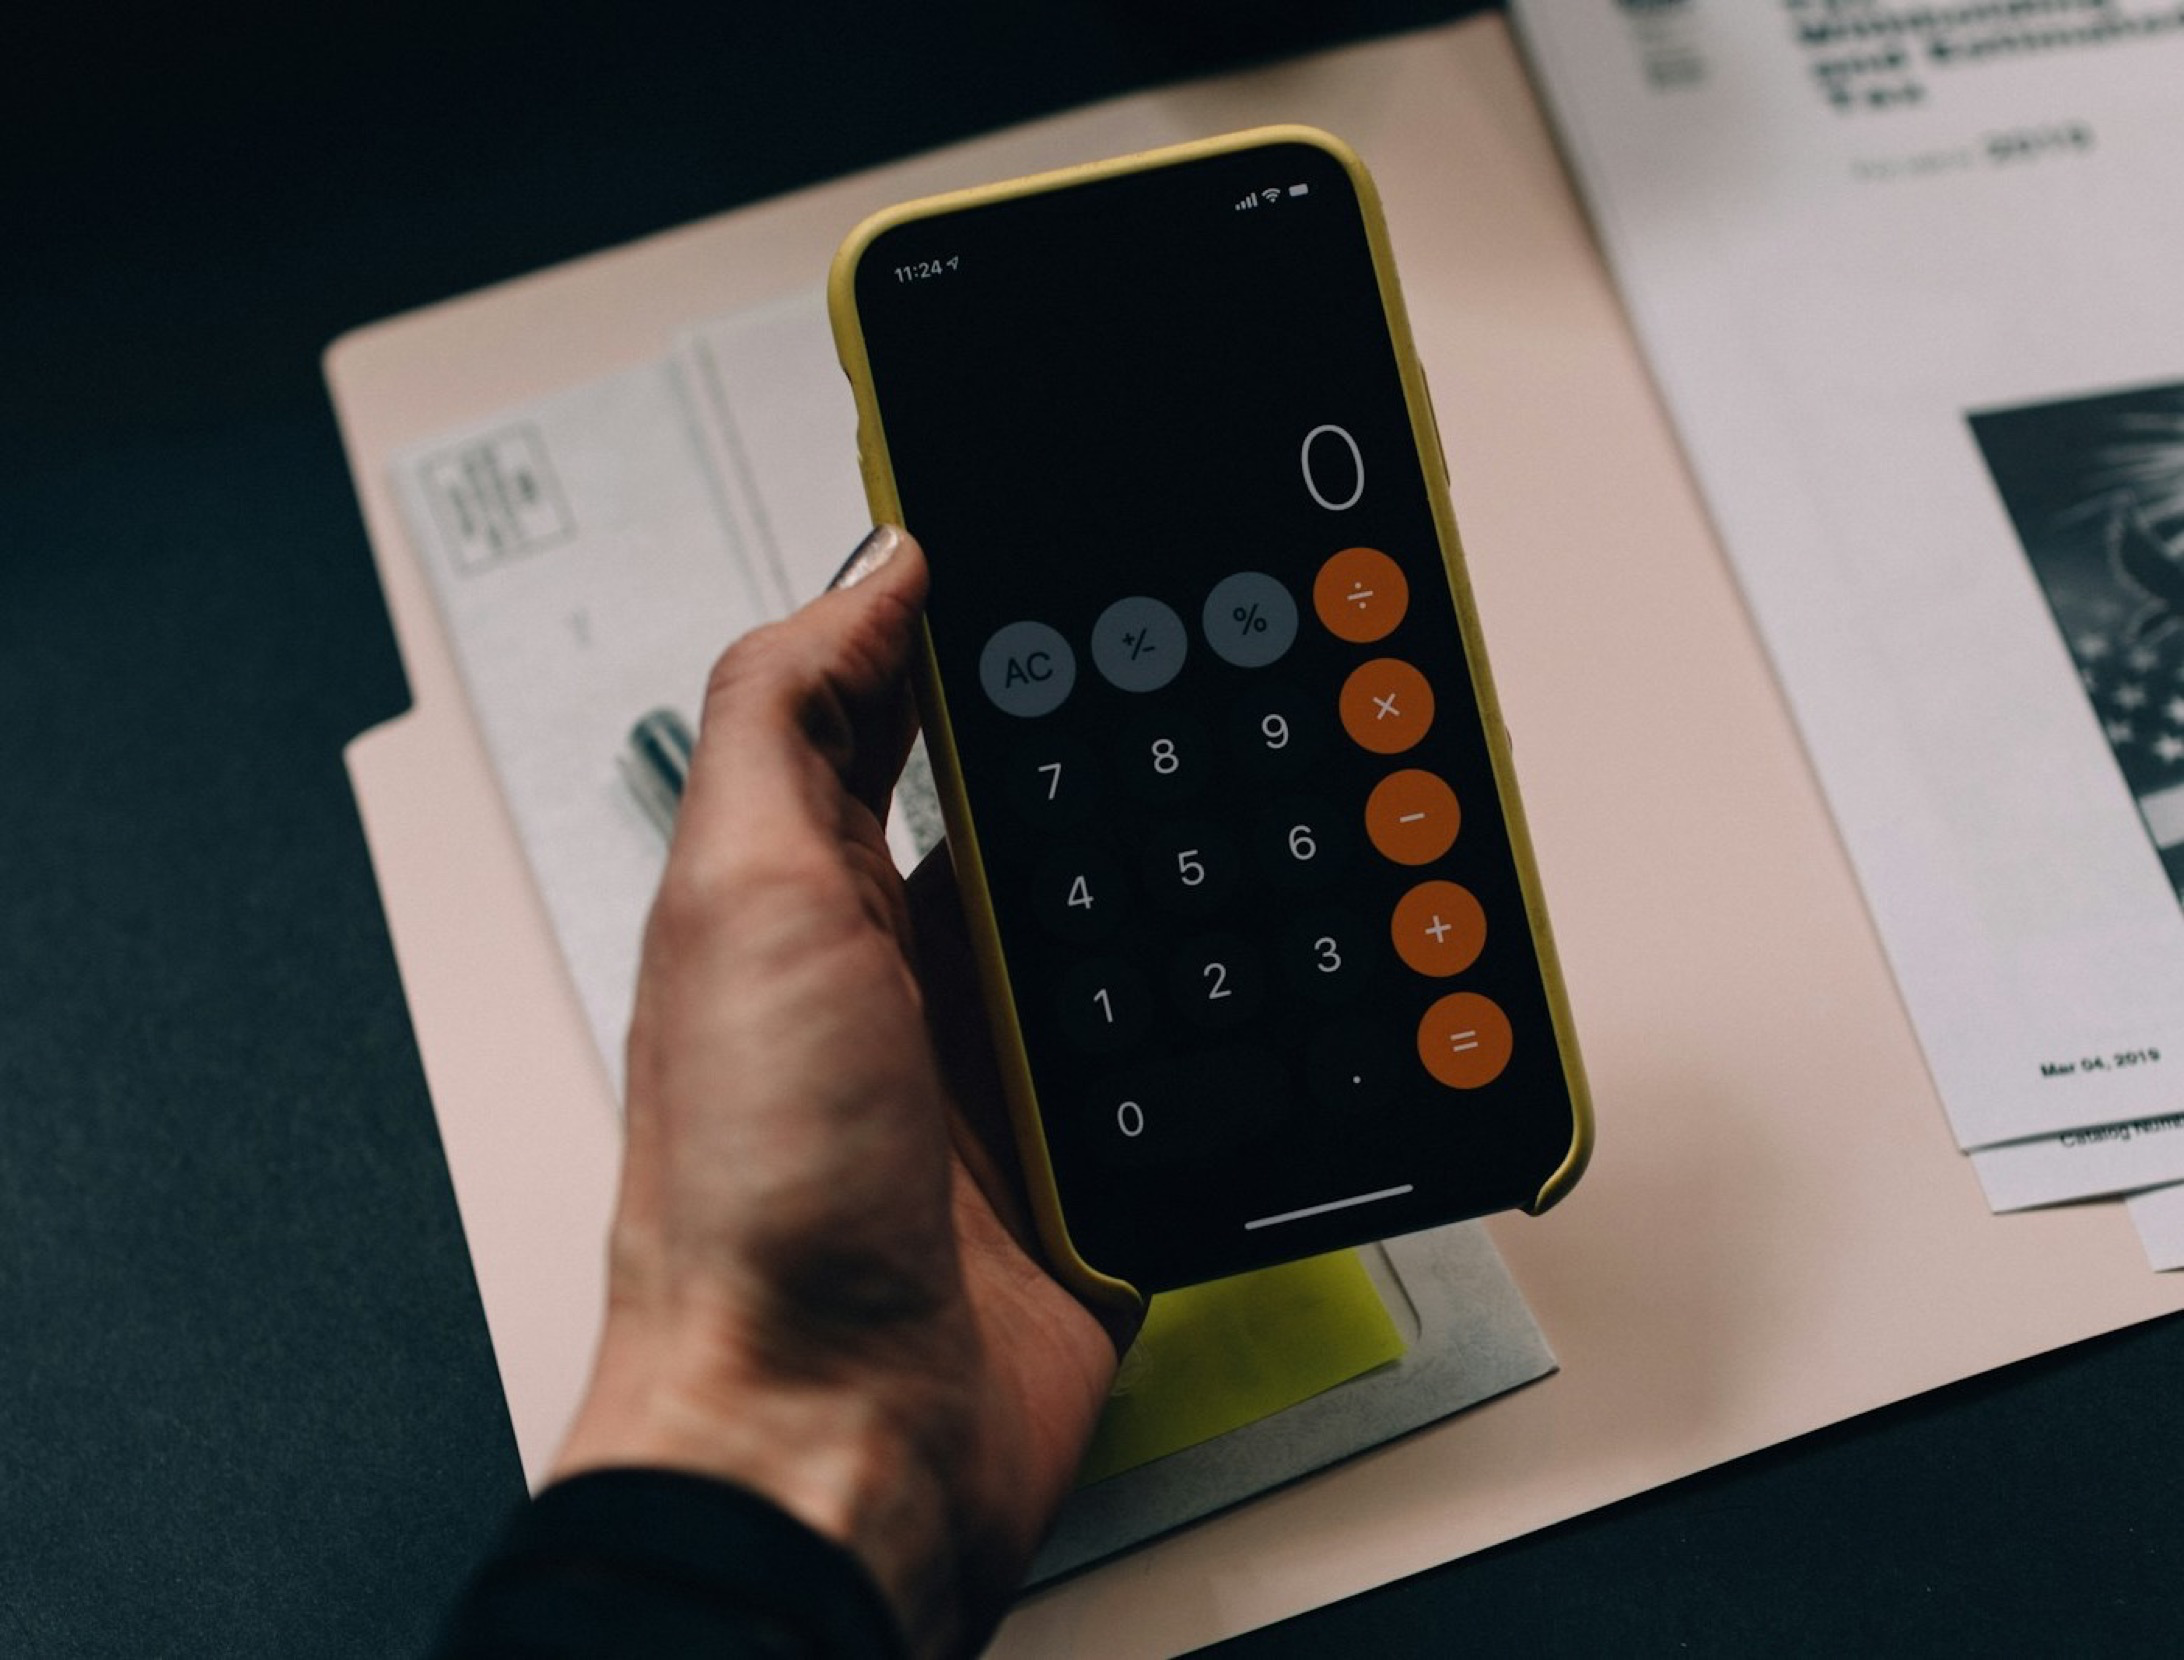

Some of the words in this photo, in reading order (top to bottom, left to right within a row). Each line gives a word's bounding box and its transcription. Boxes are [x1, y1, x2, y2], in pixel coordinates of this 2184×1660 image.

[894, 259, 942, 283] 11:24
[1301, 424, 1365, 511] 0
[1004, 651, 1054, 688] AC
[1232, 603, 1268, 636] %
[1038, 762, 1063, 800] 7
[1151, 738, 1180, 775] 8
[1261, 713, 1290, 749] 9
[1067, 875, 1095, 910] 4
[1178, 849, 1206, 886] 5
[1288, 825, 1317, 861] 6
[1093, 989, 1114, 1023] 1
[1203, 962, 1232, 1000] 2
[1314, 936, 1342, 973] 3
[2040, 1063, 2075, 1077] Mar
[2113, 1048, 2160, 1068] 2019
[1117, 1100, 1144, 1137] 0
